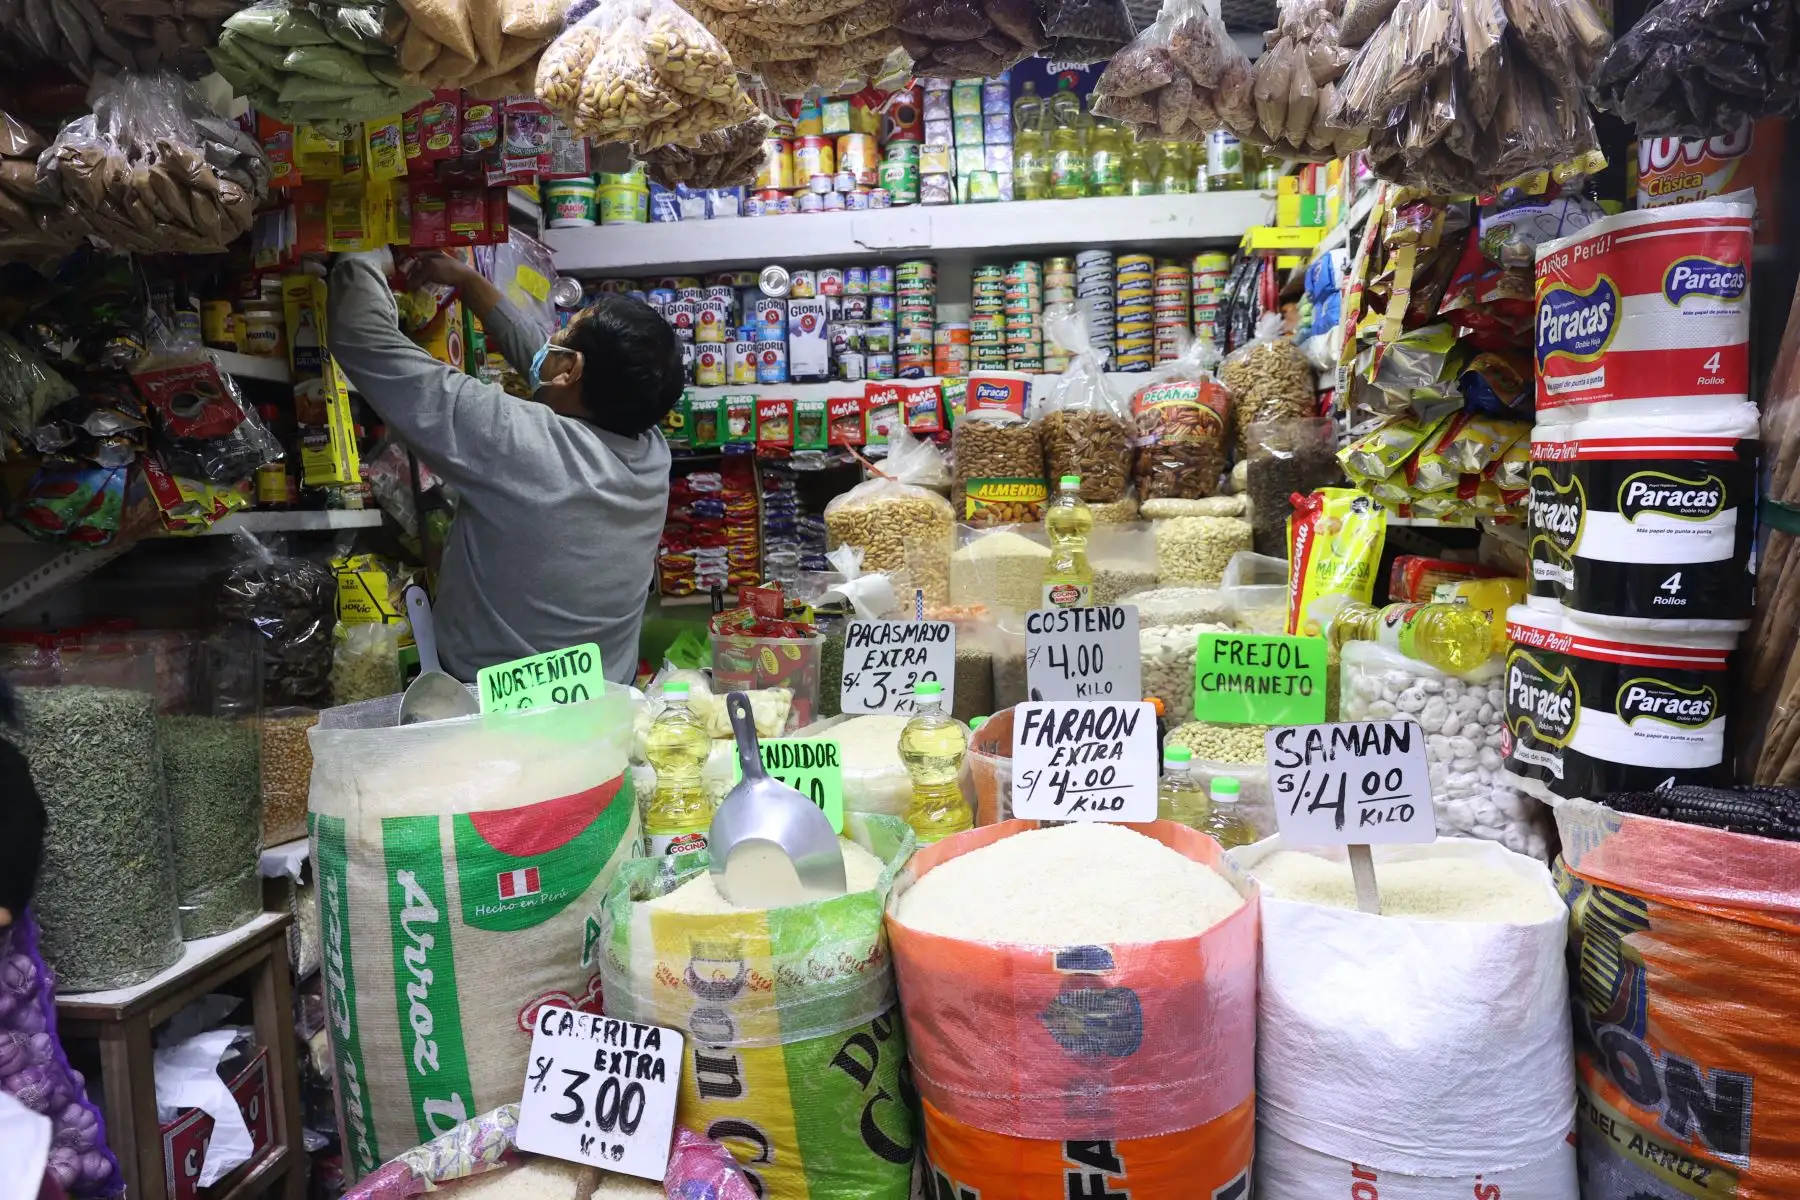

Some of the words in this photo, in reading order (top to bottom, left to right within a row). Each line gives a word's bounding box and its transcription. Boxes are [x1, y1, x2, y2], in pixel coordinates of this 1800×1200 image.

[1648, 172, 1704, 197] Clásica
[1574, 235, 1611, 263] Perú!
[1671, 266, 1745, 291] Paracas
[790, 304, 825, 318] GLORIA
[1539, 301, 1611, 347] Paracas
[736, 343, 756, 355] GLOR
[1703, 351, 1721, 374] 4
[945, 384, 966, 396] ZUK
[977, 385, 1009, 398] Paracas
[1697, 376, 1725, 386] Rollos
[691, 400, 719, 410] ZUKO
[725, 395, 754, 405] ZUKO
[796, 401, 824, 411] ZUKO
[1142, 387, 1200, 404] PECANAS
[1626, 481, 1719, 507] Paracas
[1528, 485, 1578, 535] Paracas
[1290, 523, 1309, 611] Alacena
[1660, 571, 1682, 595] 4
[1653, 595, 1687, 606] Rollos
[846, 622, 950, 649] PACASMAYO
[1545, 633, 1573, 652] Perú!
[862, 648, 927, 671] EXTRA
[1048, 643, 1104, 680] 4.00
[1213, 639, 1310, 669] FREJOL
[488, 649, 592, 702] NORTEÑITO
[1201, 673, 1313, 697] CAMANEJO
[1077, 681, 1113, 698] KILO
[1509, 665, 1571, 725] Paracas
[1625, 686, 1712, 716] Paracas
[1020, 706, 1140, 748] FARAON
[1048, 740, 1123, 767] EXTRA
[1274, 721, 1410, 769] SAMAN
[1017, 769, 1042, 798] S/
[1049, 765, 1116, 806] 4.00
[1359, 804, 1415, 827] KILO
[671, 841, 705, 853] COCINA
[475, 902, 517, 916] Hecho
[520, 899, 539, 908] en
[540, 888, 569, 904] Perú
[396, 868, 440, 1076] Arroz
[688, 938, 748, 1101] Don
[594, 1049, 666, 1083] EXTRA
[550, 1069, 646, 1136] 3.00
[1588, 1109, 1622, 1144] DEL
[1626, 1132, 1714, 1190] ARROZ
